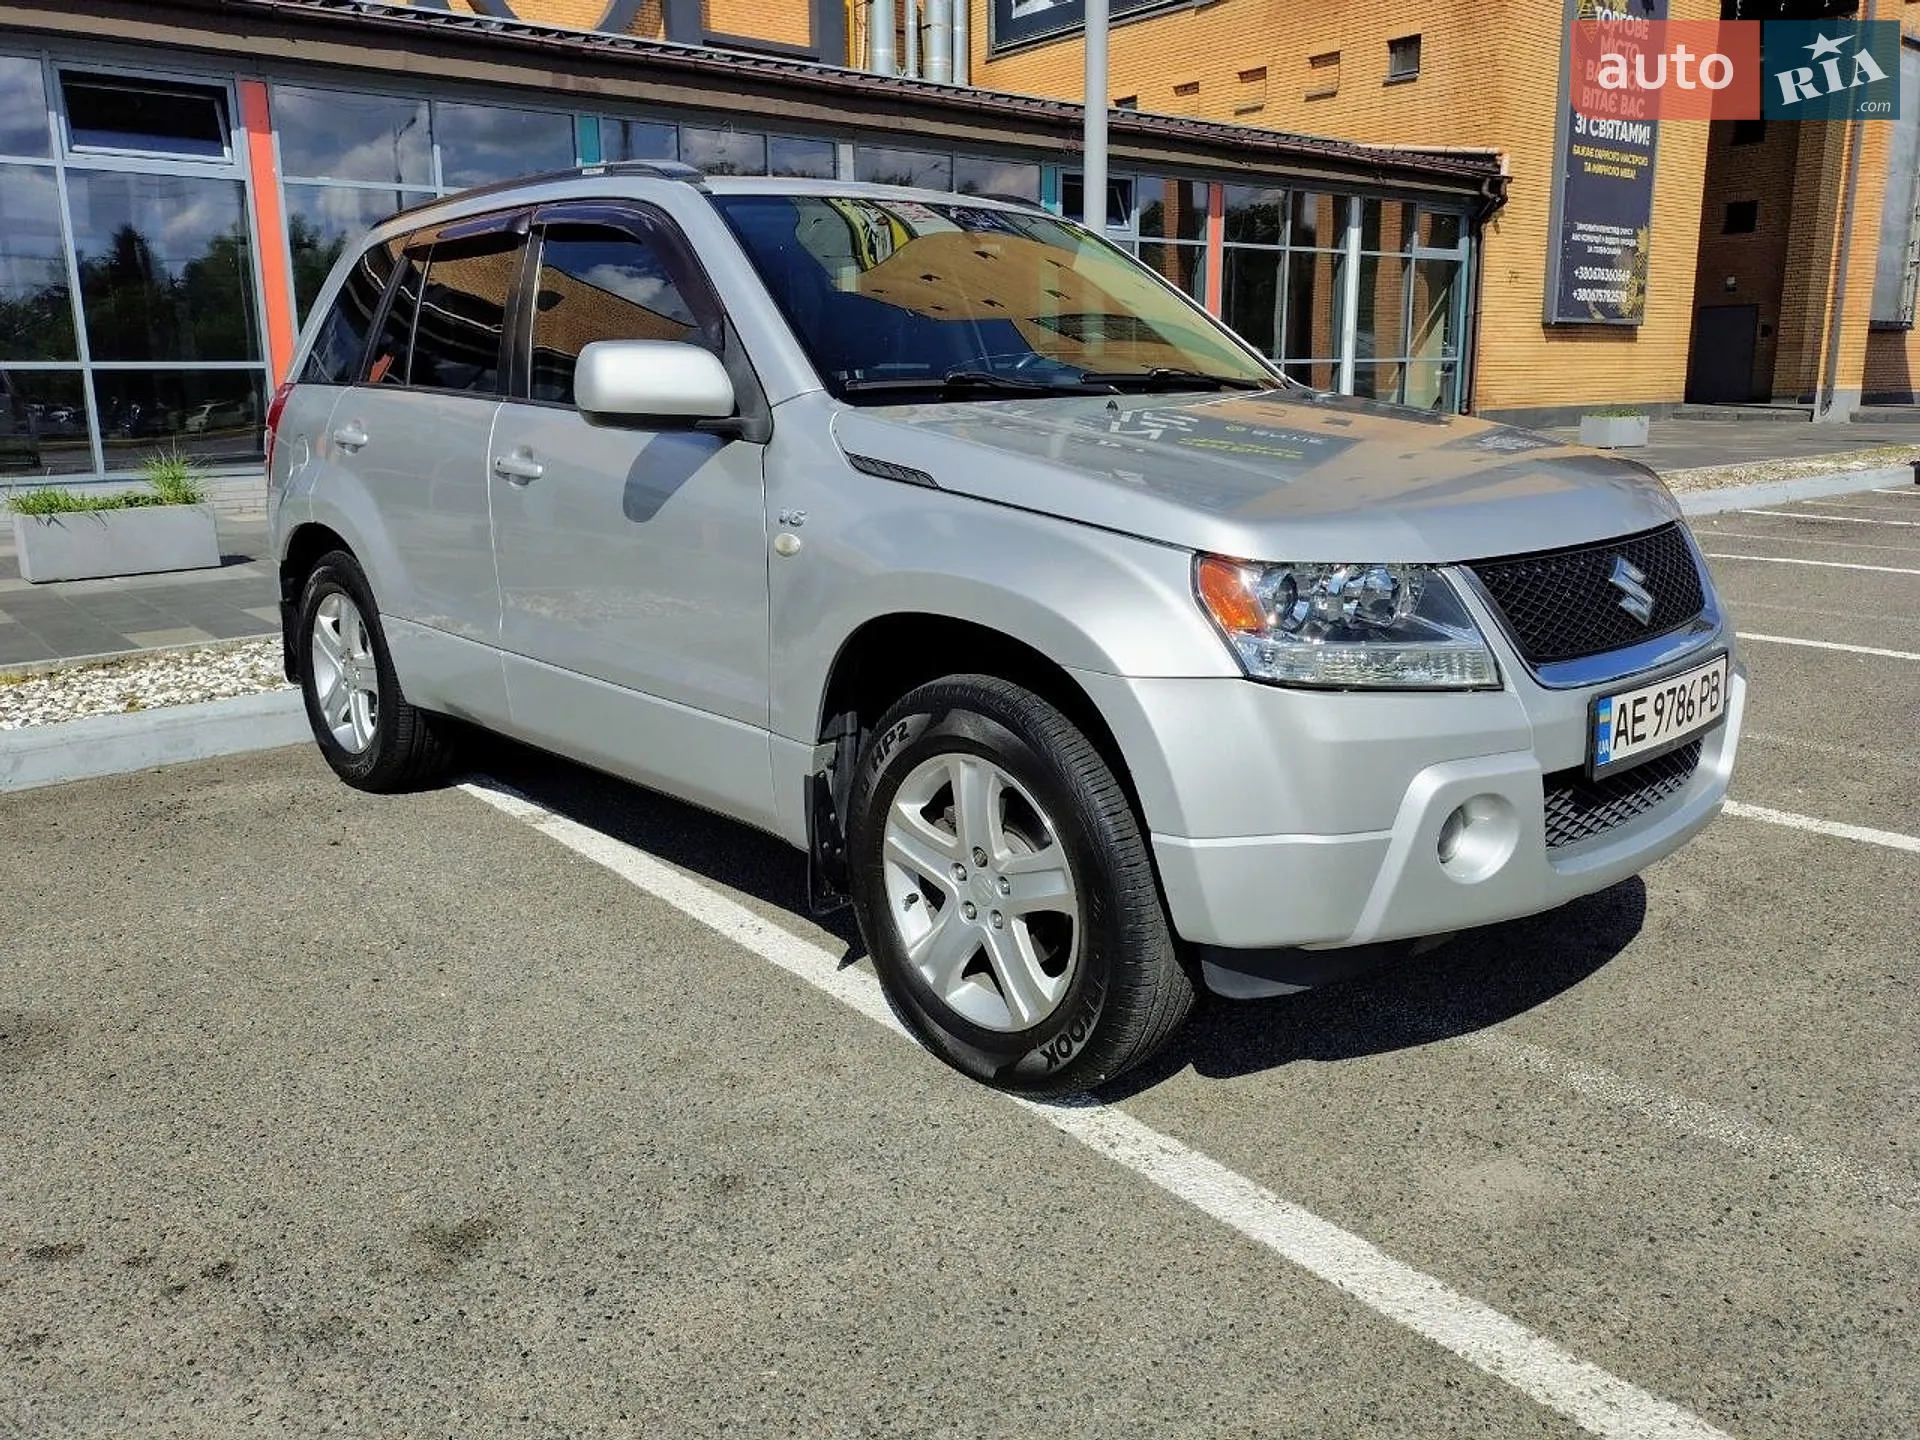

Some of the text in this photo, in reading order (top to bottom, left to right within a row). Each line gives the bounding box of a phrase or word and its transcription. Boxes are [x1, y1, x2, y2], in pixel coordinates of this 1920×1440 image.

[1582, 85, 1645, 119] ВІТАЄ ВАС
[1589, 116, 1651, 146] СВЯТАМИ!
[1613, 670, 1721, 750] AE 9786 PB
